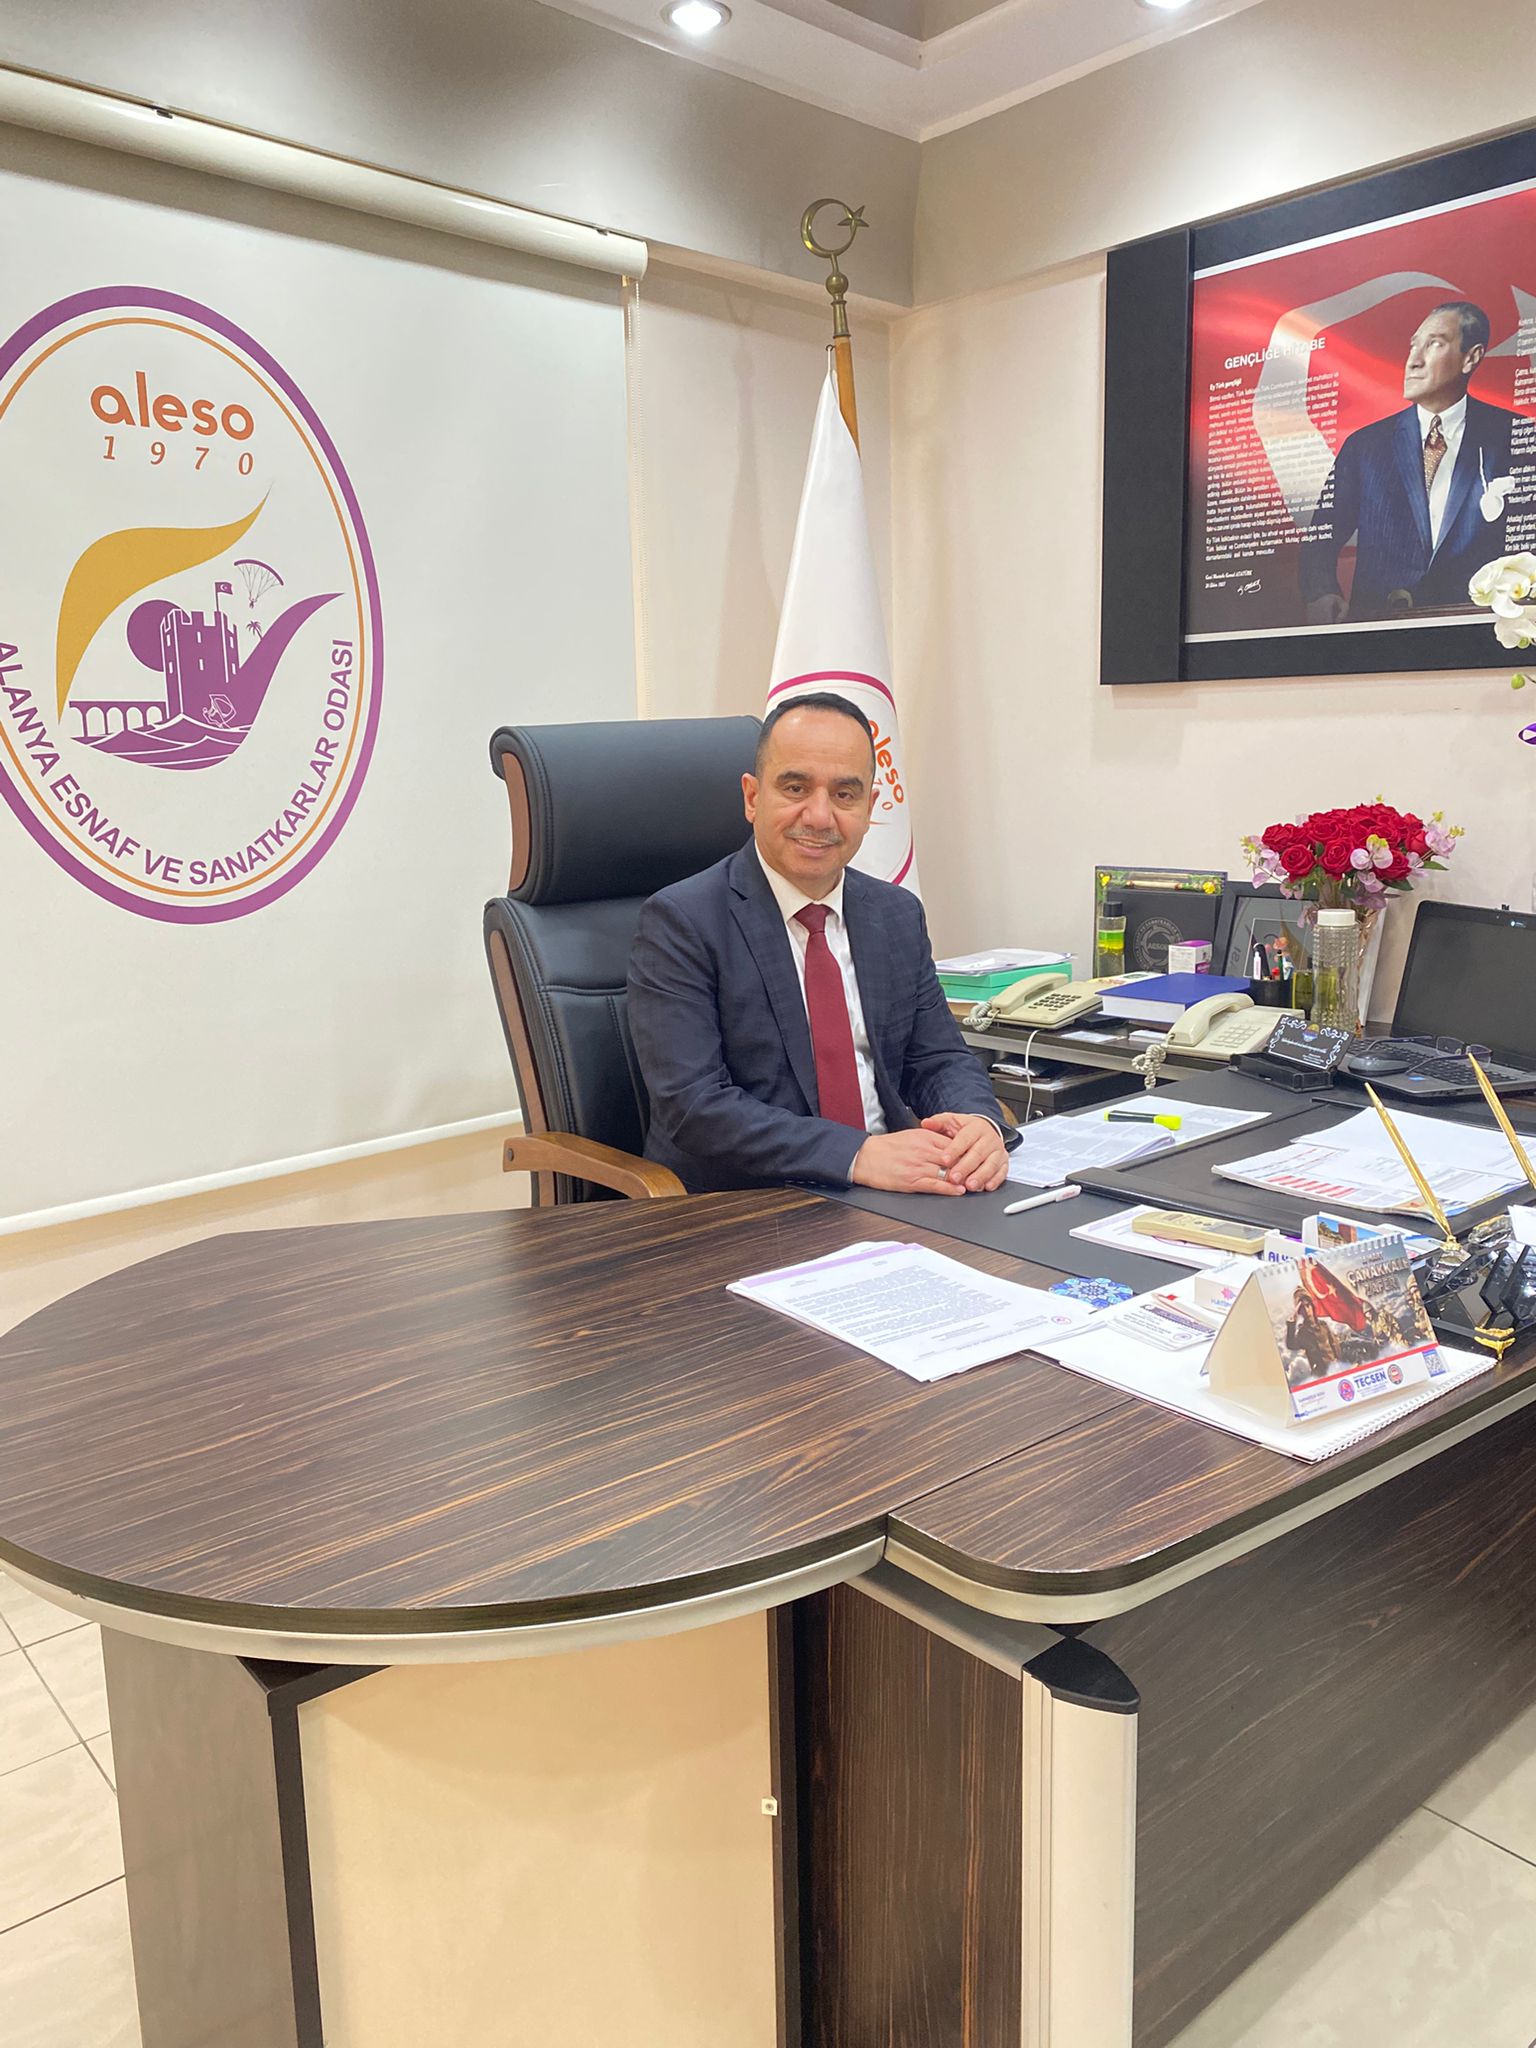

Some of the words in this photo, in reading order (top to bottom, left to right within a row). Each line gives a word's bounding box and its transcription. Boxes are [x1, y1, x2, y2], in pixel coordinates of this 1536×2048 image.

[90, 370, 256, 442] aleso
[102, 434, 255, 477] 1970
[0, 642, 61, 777] ALANYA
[50, 773, 141, 859] ESNAF
[144, 848, 183, 884] VE
[189, 736, 340, 885] SANATKARLAR
[323, 639, 353, 732] ODASI
[1354, 1371, 1388, 1389] TECSEN
